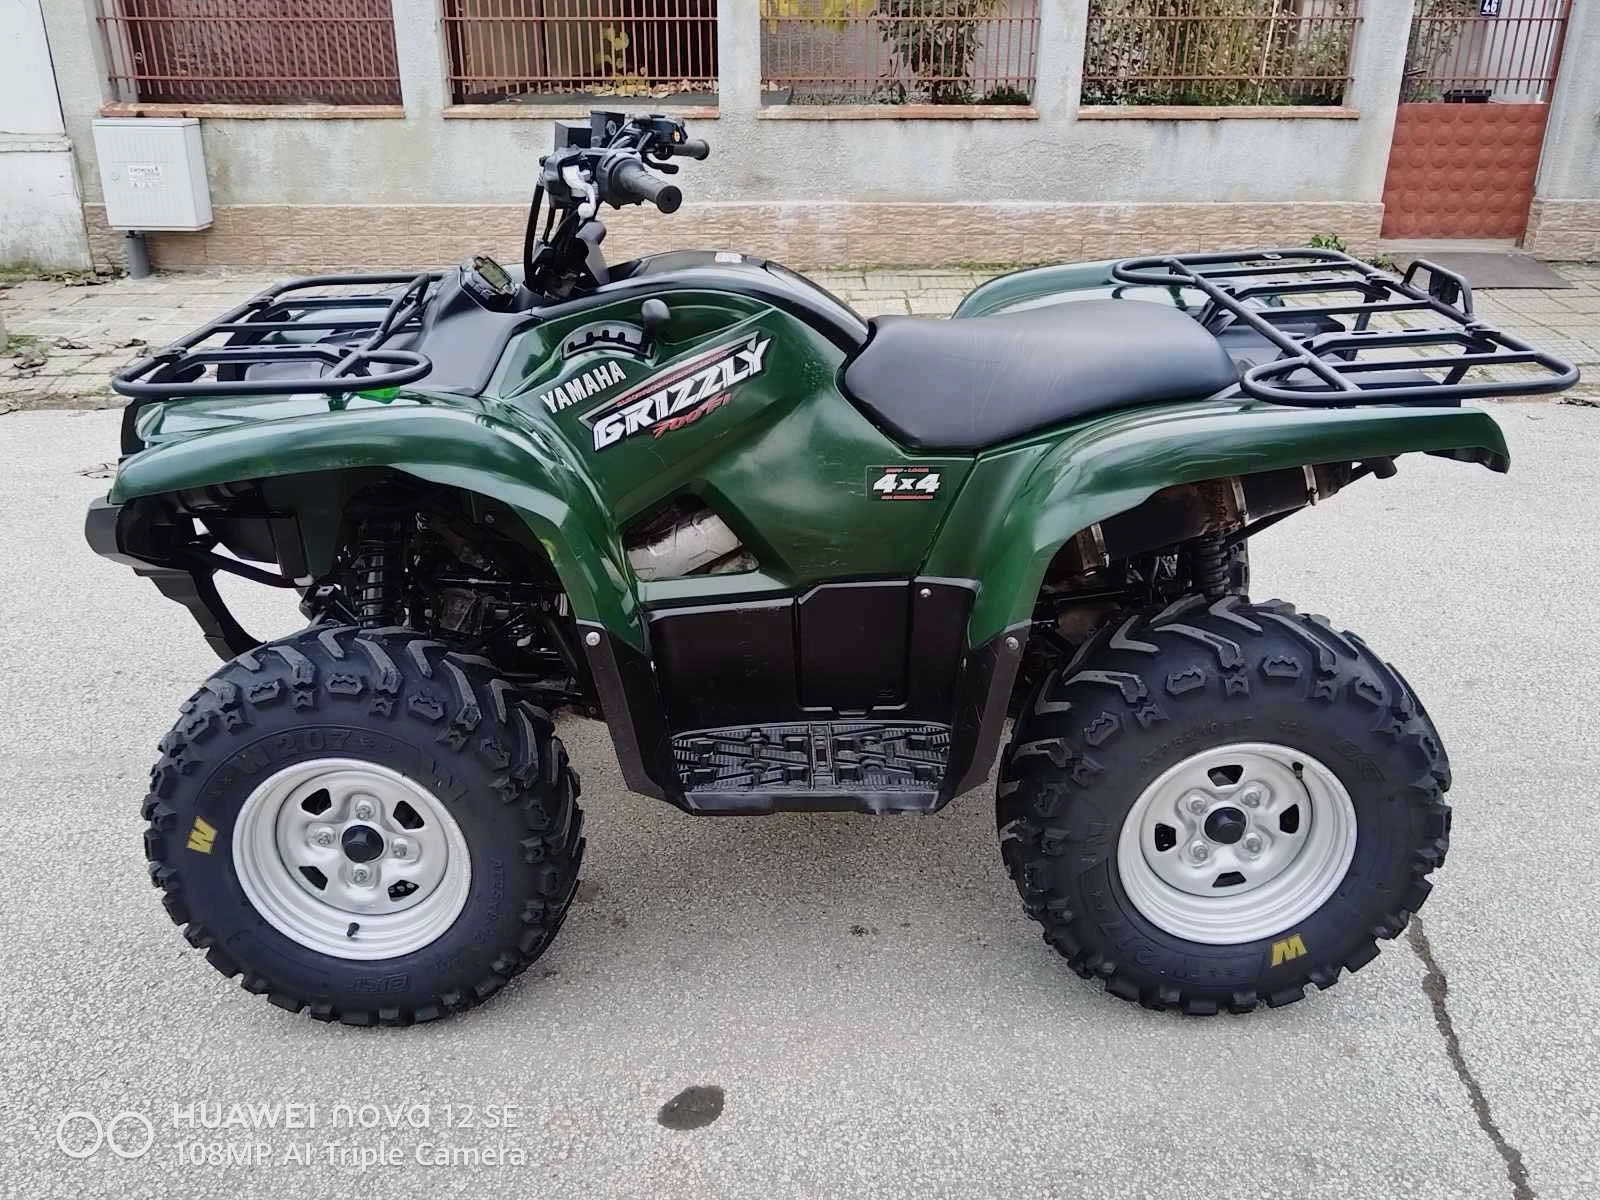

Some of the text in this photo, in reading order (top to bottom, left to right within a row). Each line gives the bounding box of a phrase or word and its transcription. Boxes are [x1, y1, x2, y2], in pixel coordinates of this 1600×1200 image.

[540, 359, 627, 414] YAMAHA
[593, 337, 772, 451] GRIZZLY
[872, 473, 940, 493] 4x4
